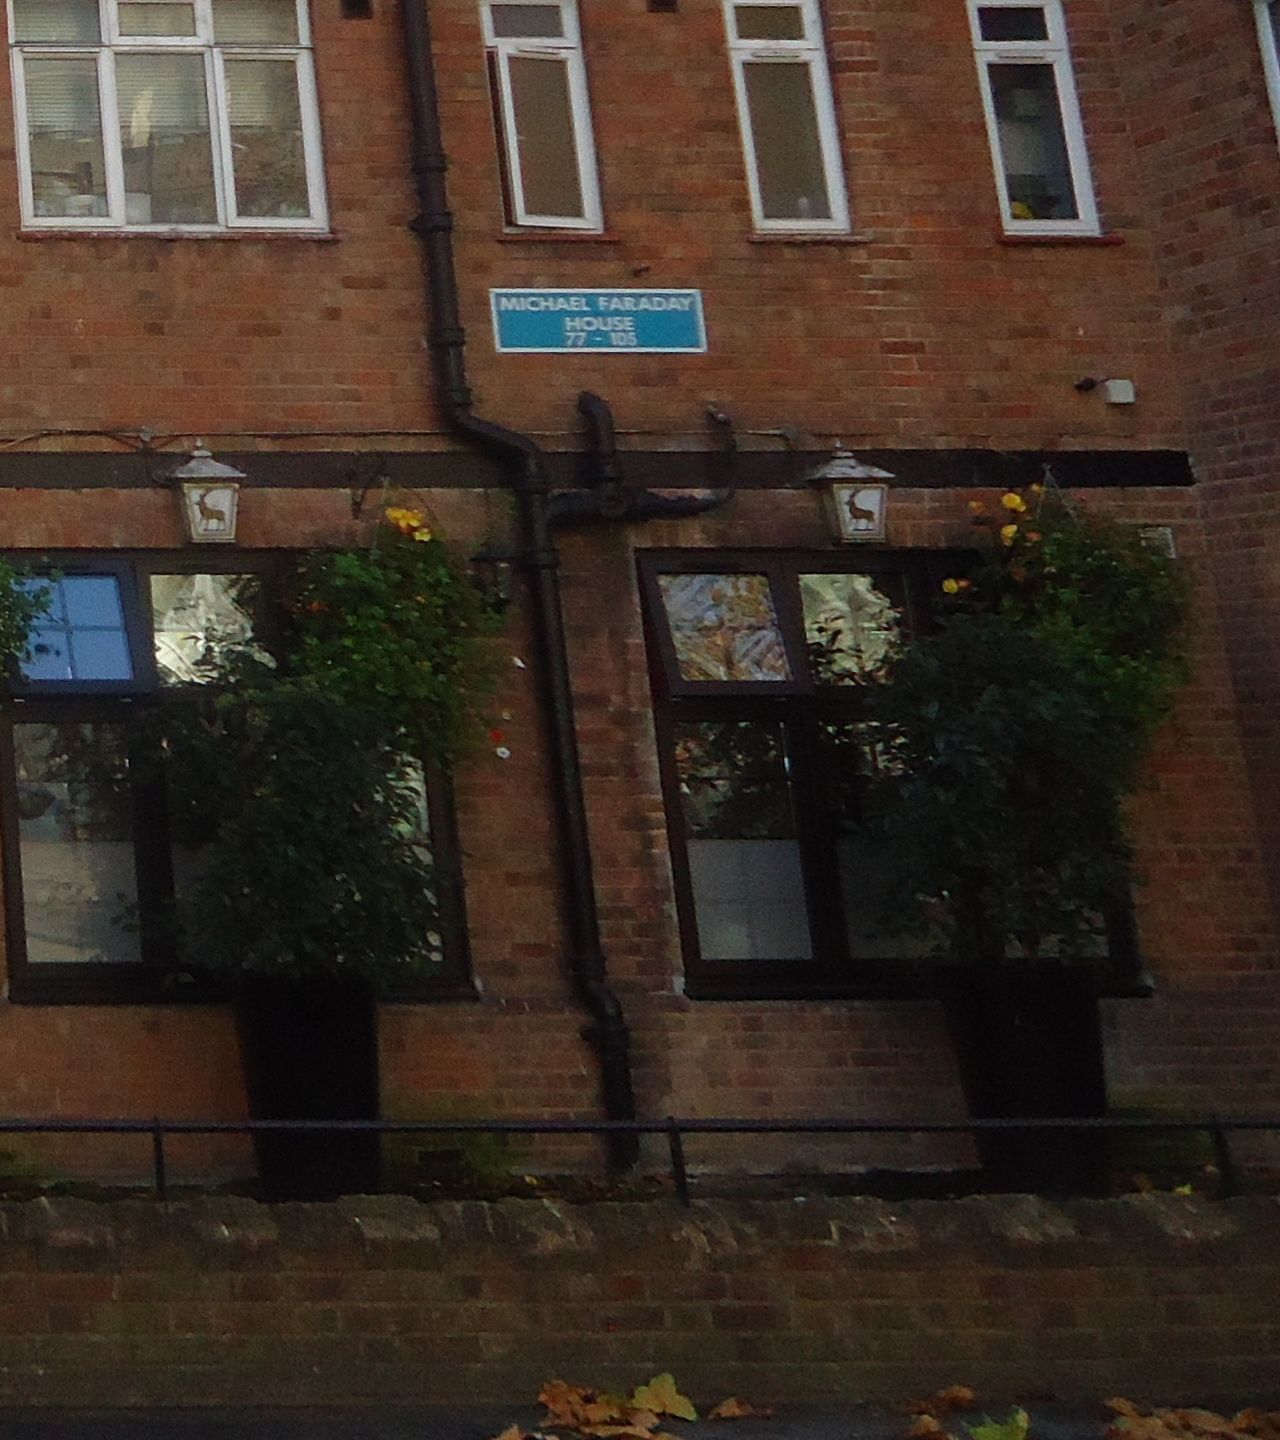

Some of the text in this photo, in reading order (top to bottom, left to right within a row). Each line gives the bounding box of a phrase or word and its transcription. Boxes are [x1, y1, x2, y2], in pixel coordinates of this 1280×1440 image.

[500, 297, 691, 311] MICHAEL FARADAY
[565, 317, 635, 331] HOUSE
[566, 332, 587, 345] 77
[611, 332, 638, 346] 105
